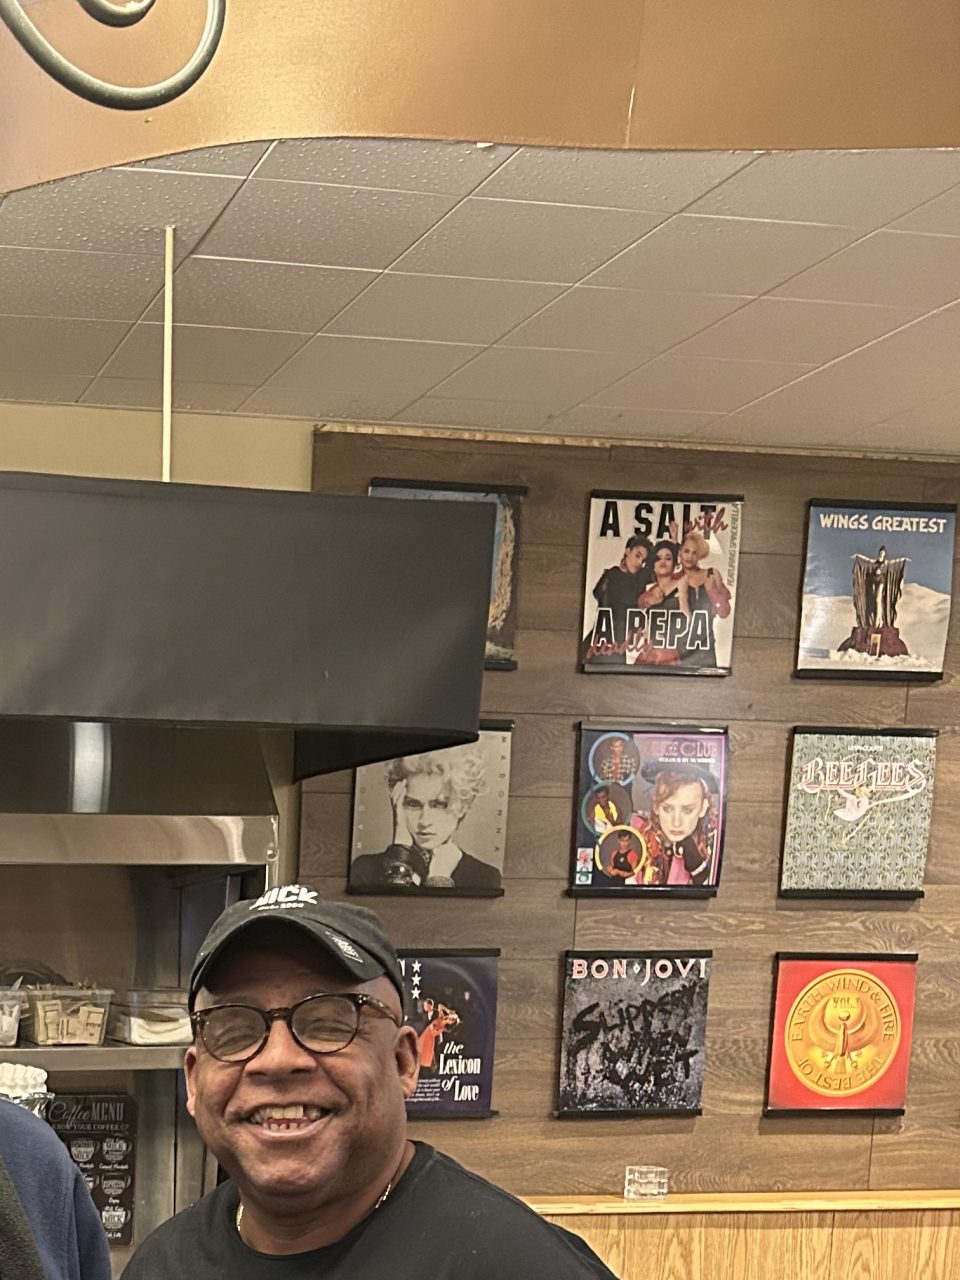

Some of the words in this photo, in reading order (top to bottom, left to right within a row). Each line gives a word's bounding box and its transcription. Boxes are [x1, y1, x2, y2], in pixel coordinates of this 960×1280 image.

[600, 501, 620, 537] A
[634, 502, 716, 540] SALT
[820, 514, 868, 529] WINGS
[872, 515, 947, 533] GREATEST
[591, 608, 614, 647] A
[626, 608, 710, 650] PEPA
[680, 740, 717, 756] CLUB
[797, 757, 853, 793] BEE
[854, 757, 928, 793] GEES
[249, 884, 318, 911] NICK
[571, 959, 628, 979] BON
[640, 958, 707, 986] JOVI
[792, 992, 824, 1042] EARTH
[825, 977, 871, 994] WIND
[870, 990, 881, 1004] &
[880, 1004, 895, 1043] FIRE
[444, 1041, 464, 1055] the
[439, 1054, 481, 1075] Lexicon
[441, 1076, 457, 1091] of
[454, 1080, 479, 1101] Love
[815, 1074, 852, 1091] BEST
[48, 1101, 91, 1129] Coffee
[92, 1102, 124, 1121] MENU
